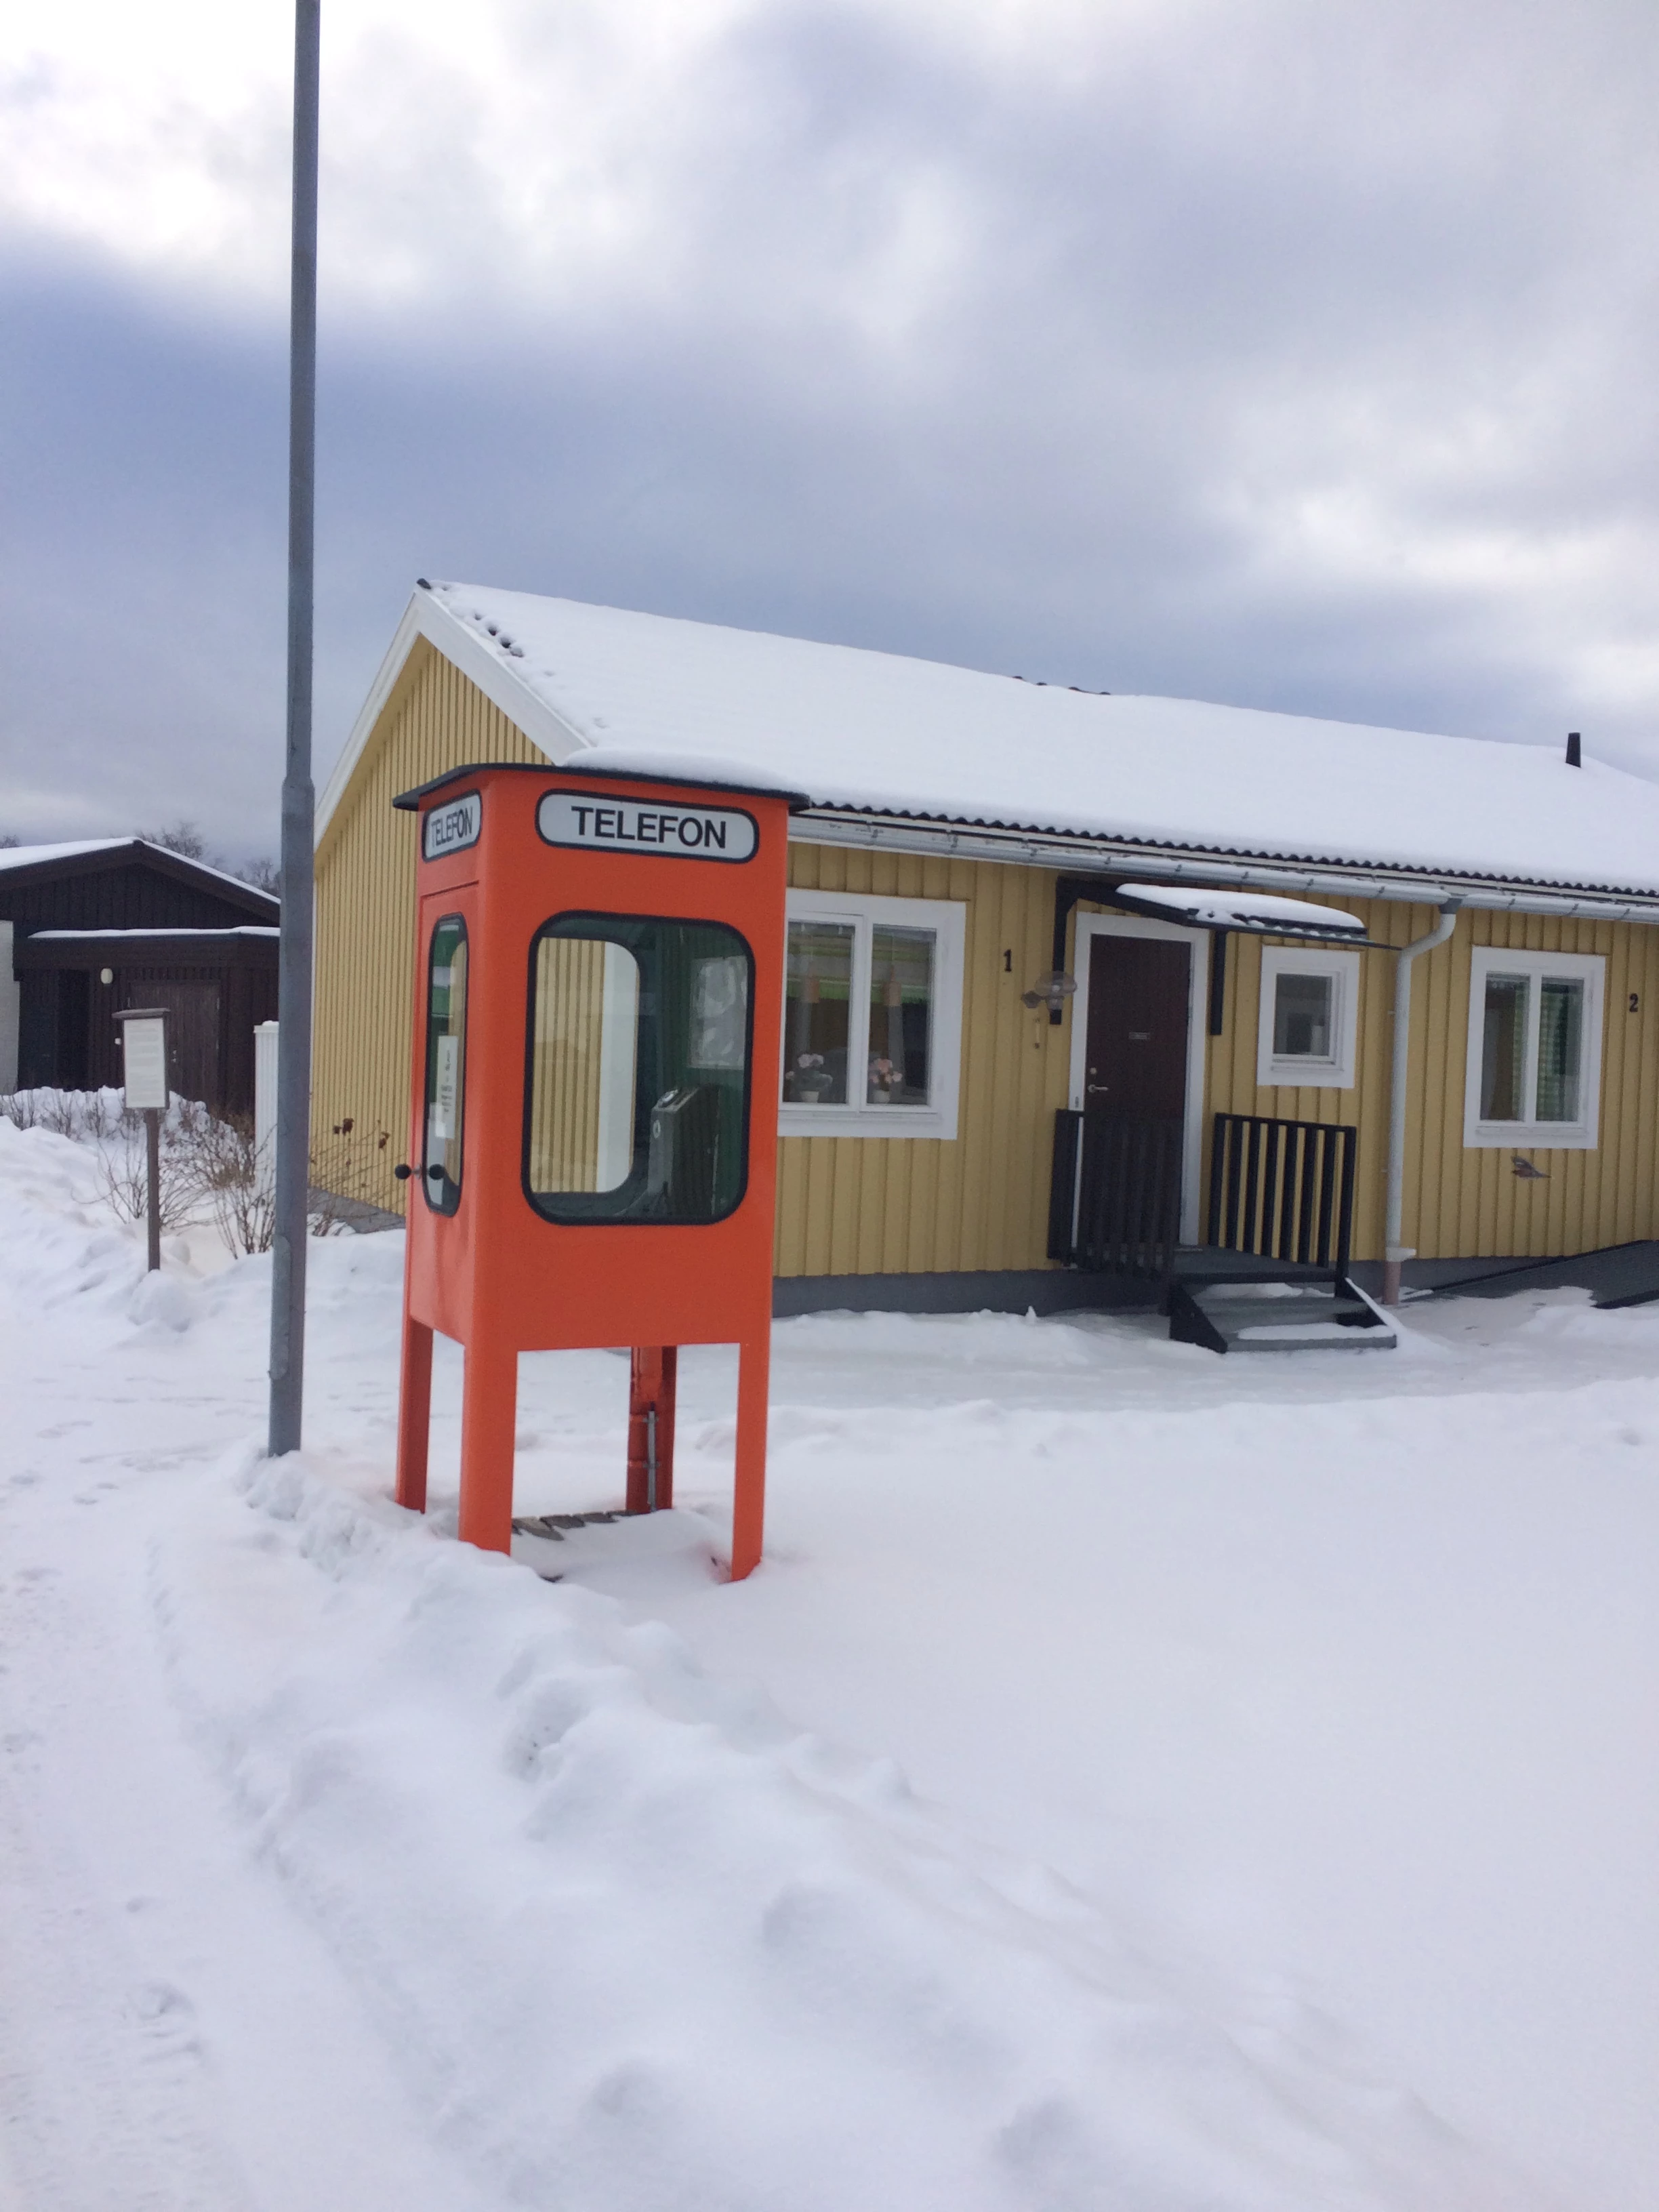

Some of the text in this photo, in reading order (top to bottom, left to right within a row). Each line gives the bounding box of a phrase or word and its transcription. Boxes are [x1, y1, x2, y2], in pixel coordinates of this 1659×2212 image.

[431, 806, 473, 848] TELEFON
[571, 805, 726, 849] TELEFON
[1003, 949, 1012, 972] 1
[1629, 993, 1639, 1012] 2
